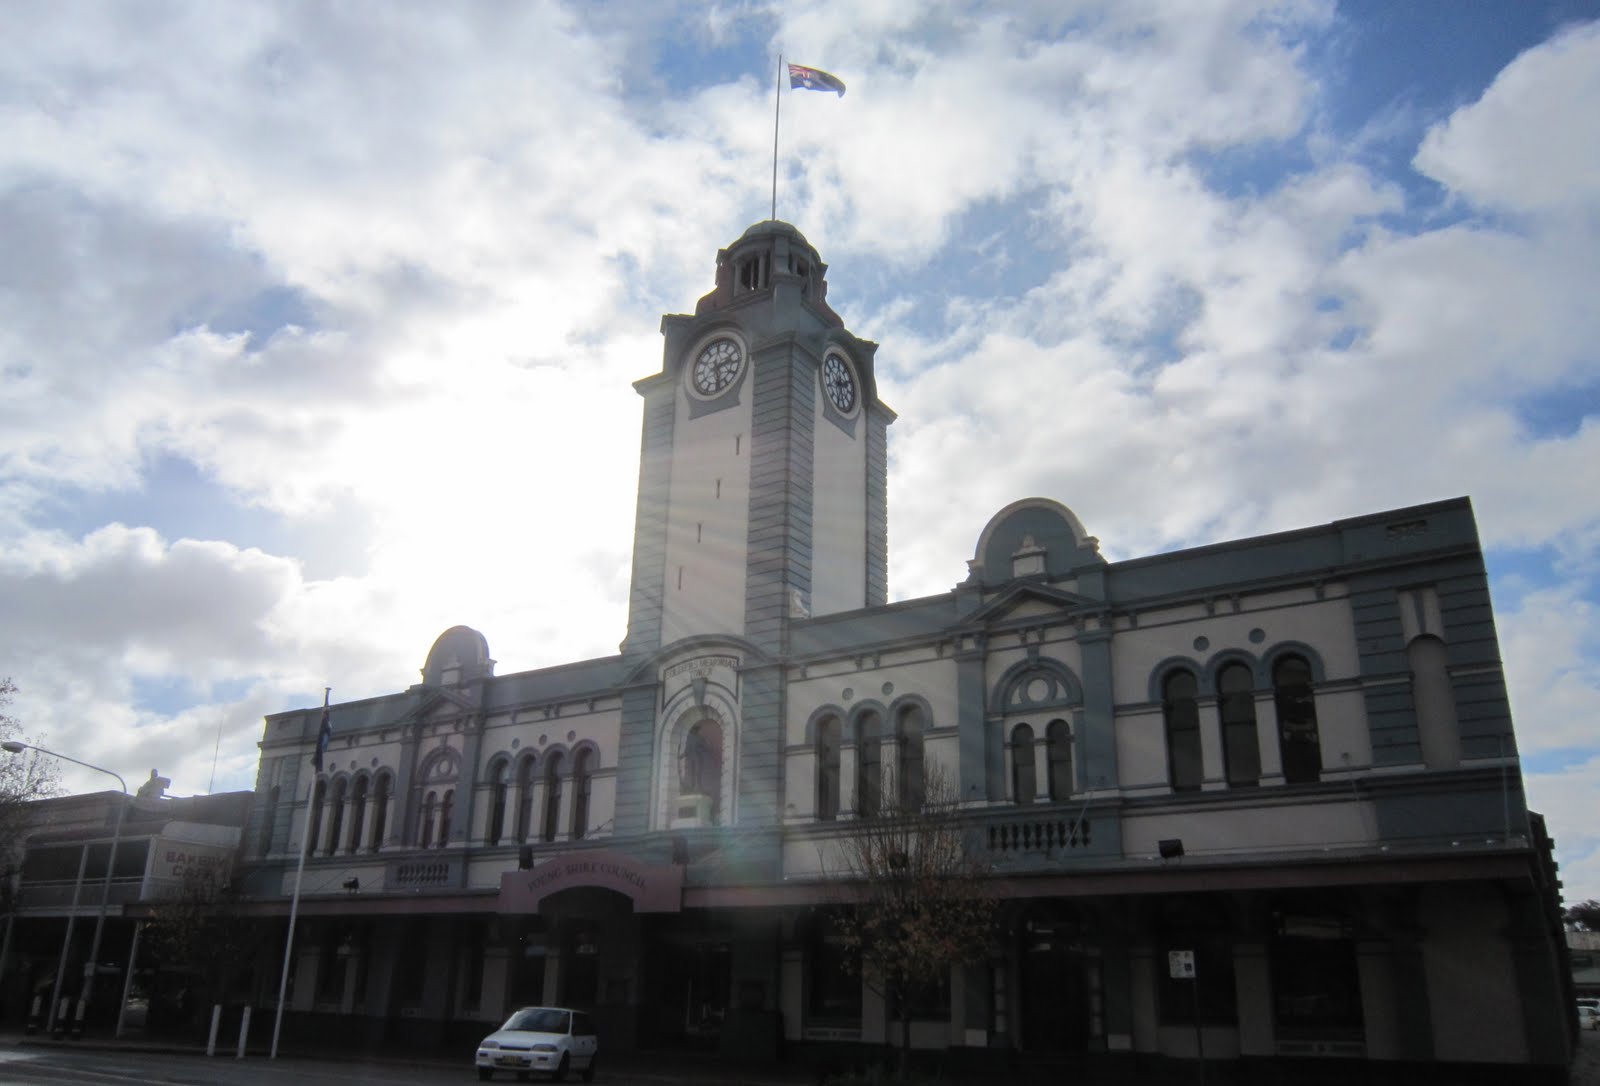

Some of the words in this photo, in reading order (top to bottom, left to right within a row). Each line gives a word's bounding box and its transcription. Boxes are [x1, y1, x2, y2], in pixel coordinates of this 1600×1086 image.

[528, 867, 561, 892] YOUNG
[566, 863, 596, 875] SHIRE
[600, 864, 645, 889] COUNCIL
